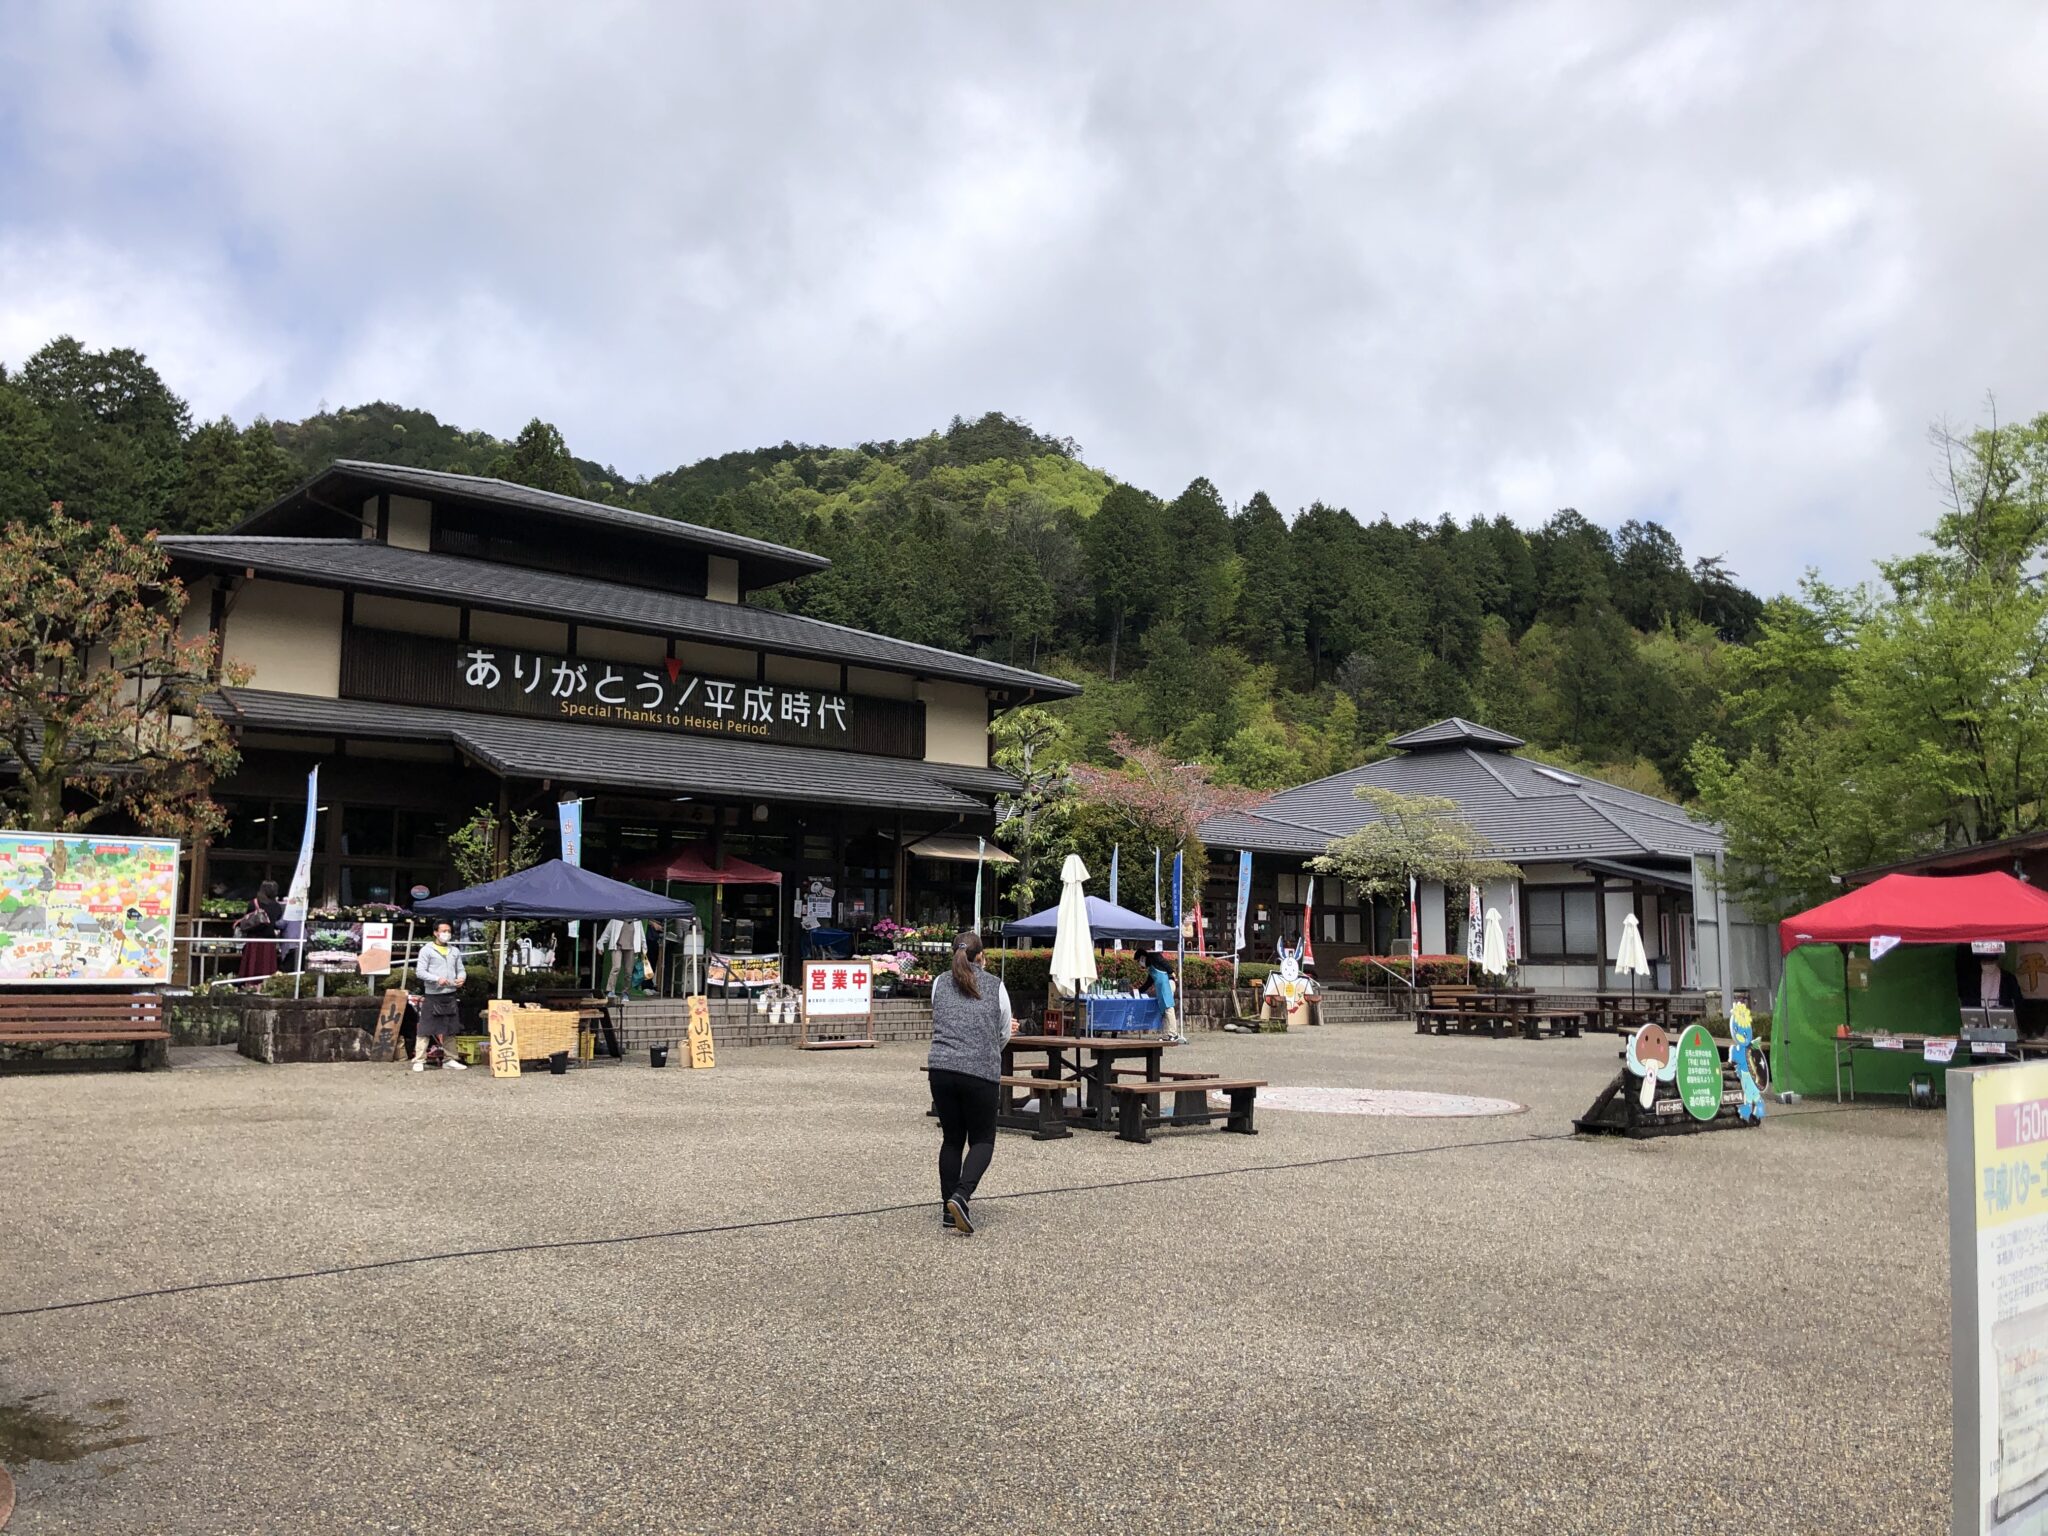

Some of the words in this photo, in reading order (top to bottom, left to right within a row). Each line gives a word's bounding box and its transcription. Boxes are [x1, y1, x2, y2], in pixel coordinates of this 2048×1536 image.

[561, 700, 611, 717] Special
[615, 706, 662, 724] Thanks
[666, 713, 680, 725] to
[685, 714, 723, 730] Heisei
[727, 720, 770, 735] Period.
[811, 969, 867, 990] 営業中
[374, 1003, 402, 1054] 山栗
[493, 1023, 518, 1072] 山栗
[694, 1017, 714, 1063] 山栗
